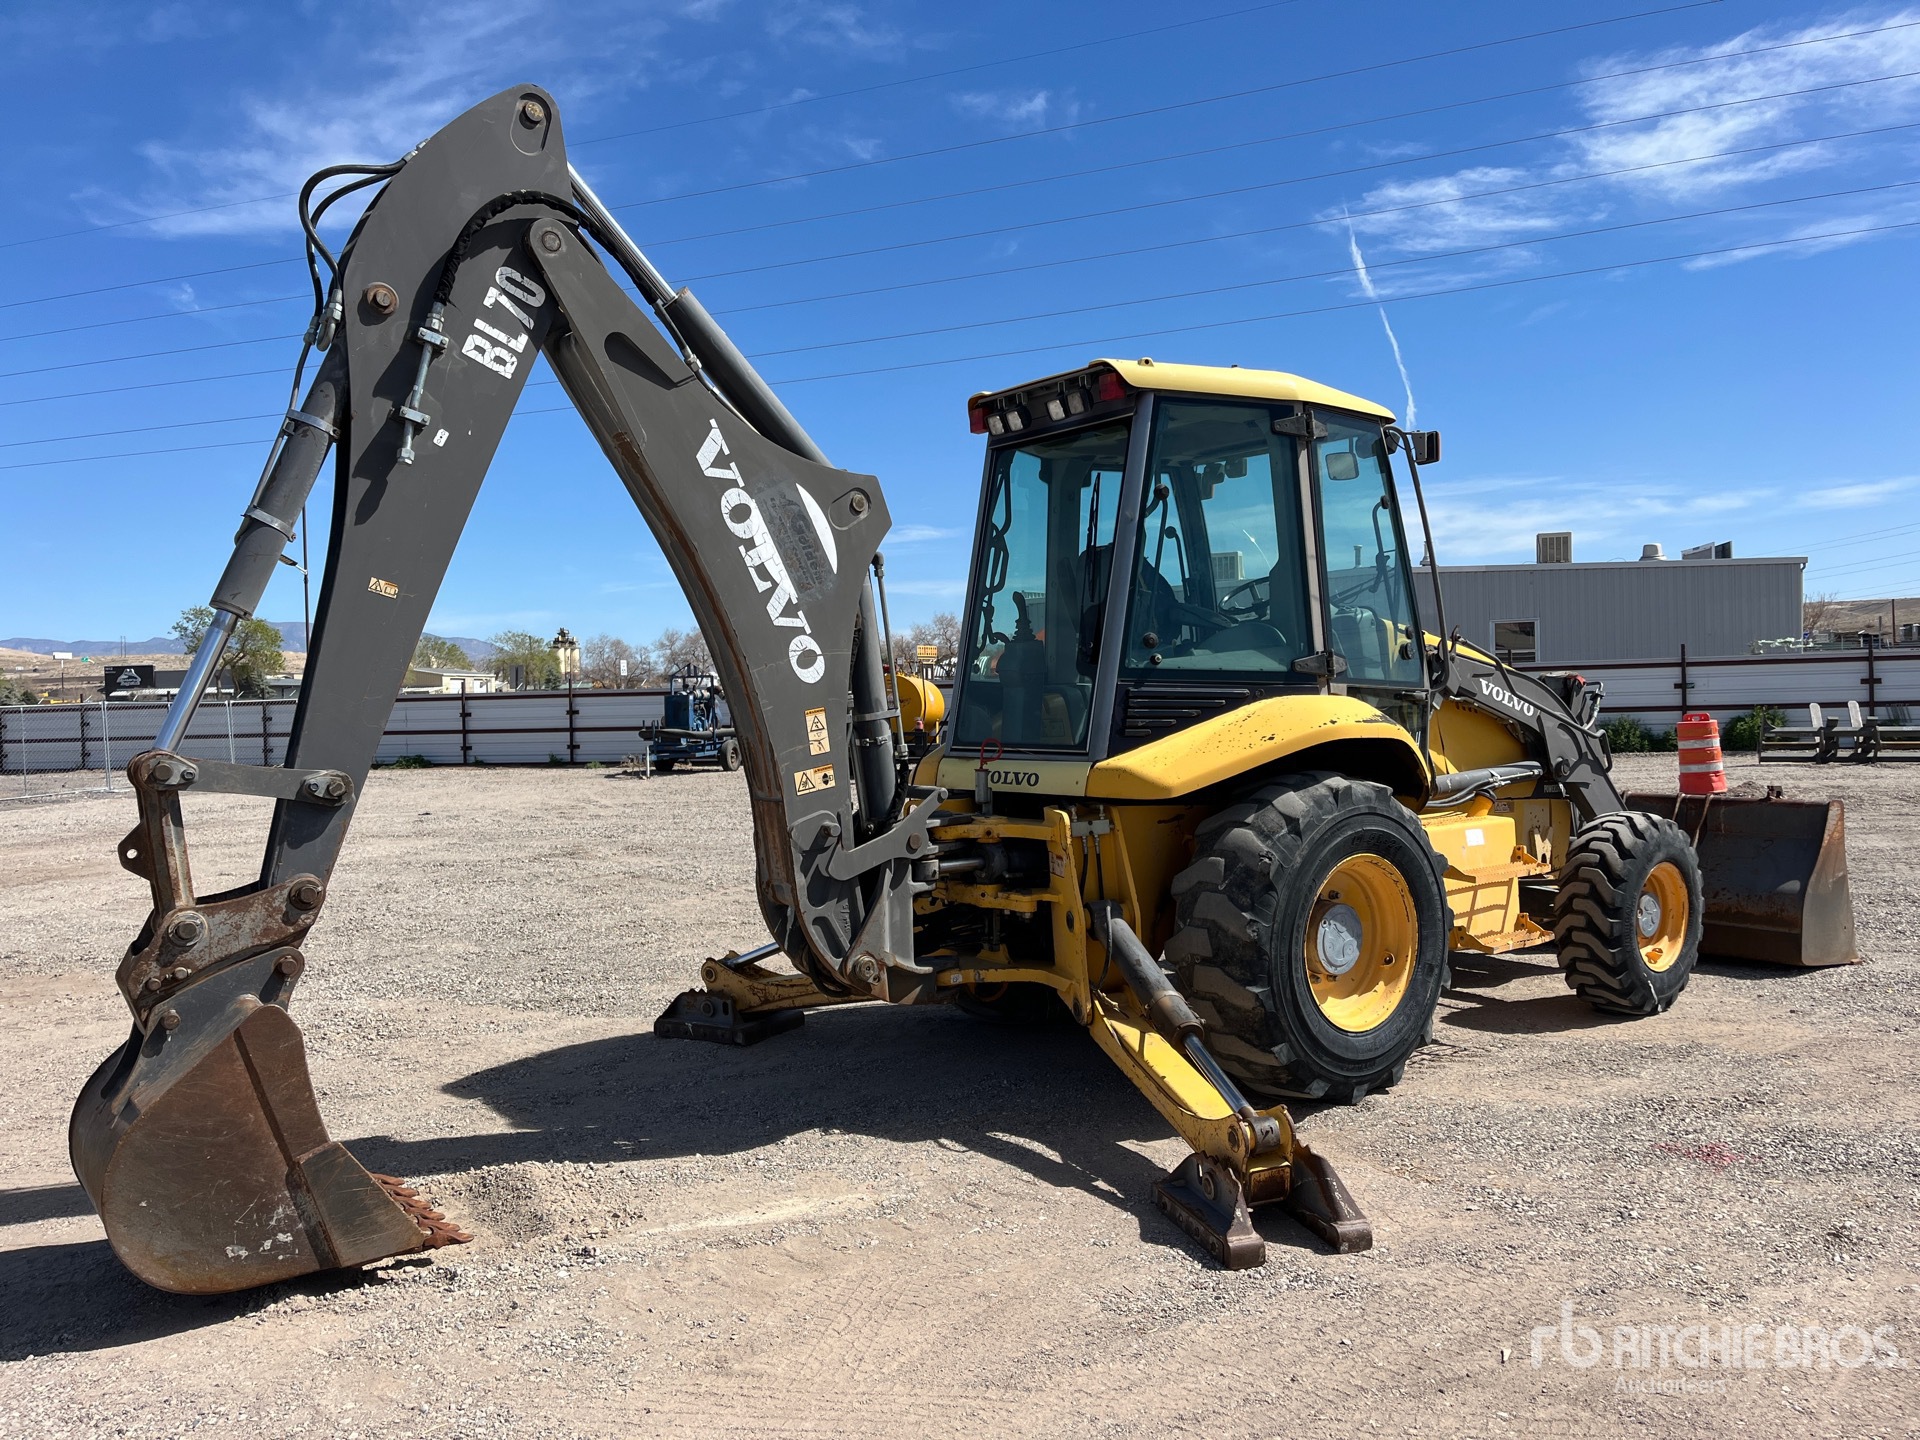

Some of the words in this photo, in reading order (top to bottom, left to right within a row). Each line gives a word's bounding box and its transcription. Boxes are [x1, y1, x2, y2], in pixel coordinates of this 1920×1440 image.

[462, 266, 546, 379] BL70
[696, 418, 825, 684] VOLVO
[1479, 678, 1534, 717] VOLVO
[987, 770, 1040, 787] OLVO
